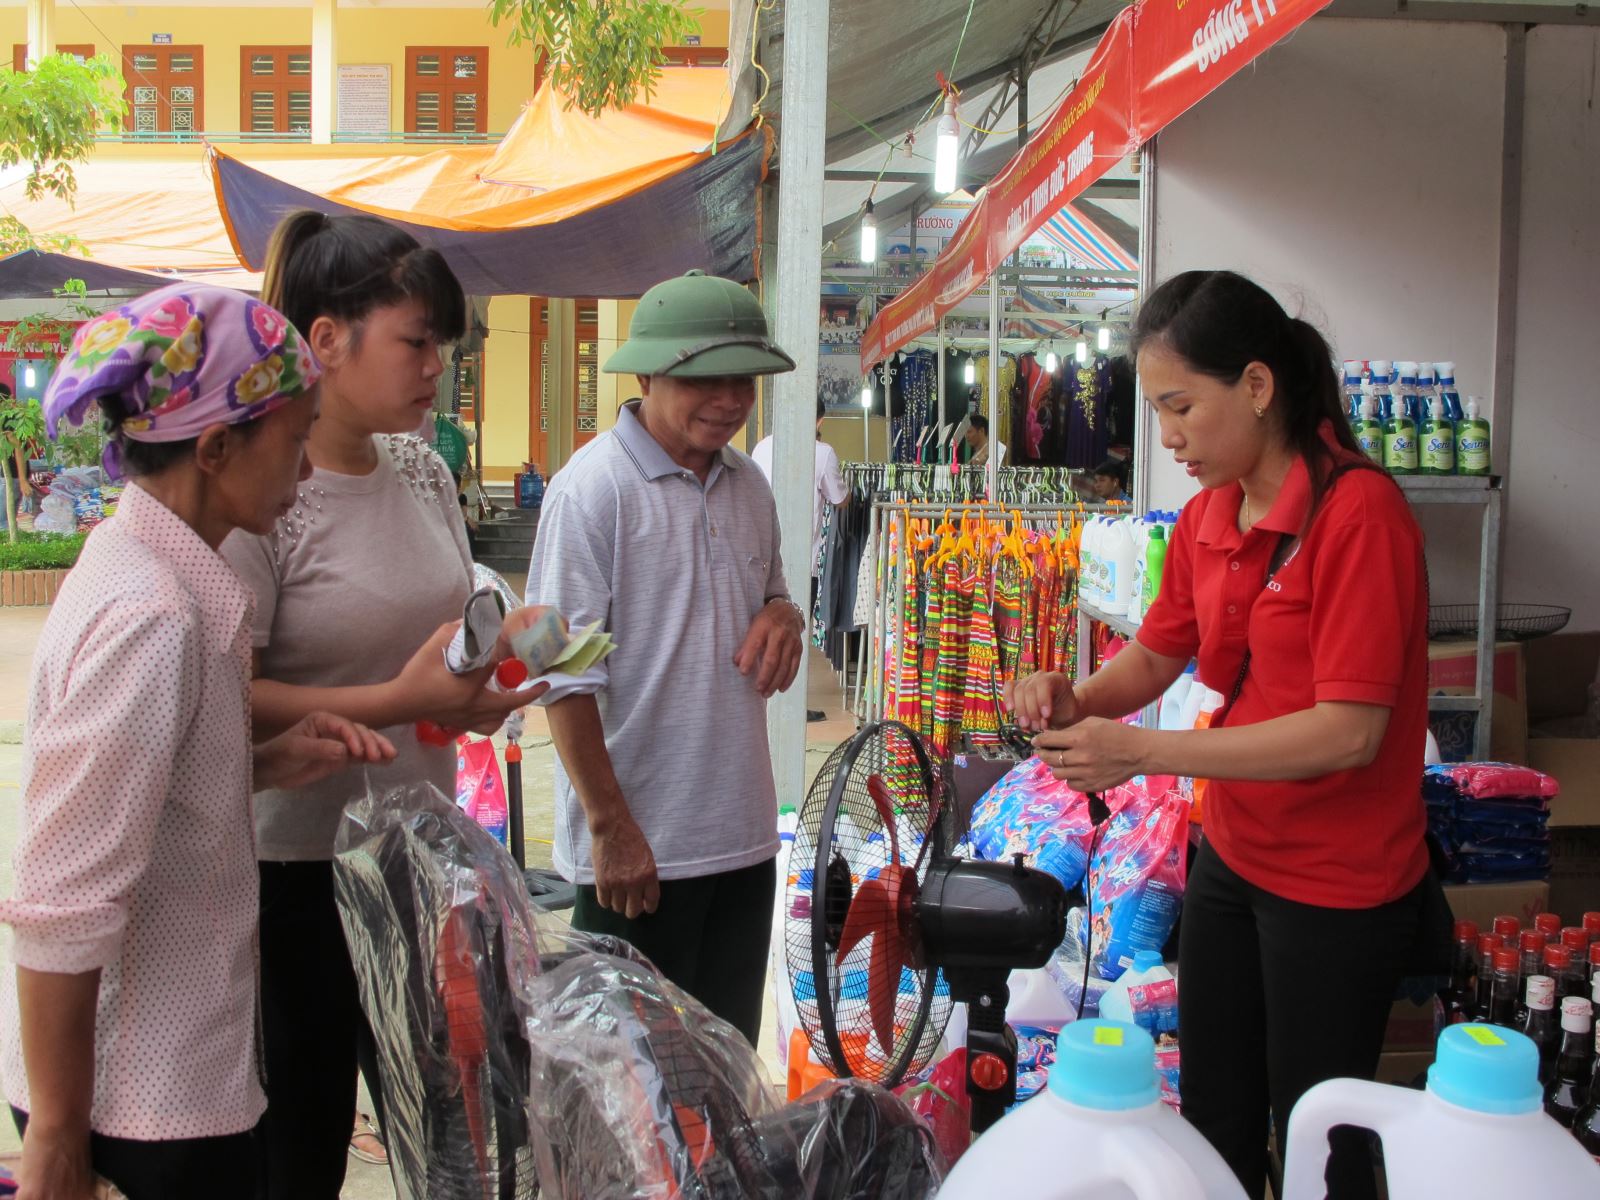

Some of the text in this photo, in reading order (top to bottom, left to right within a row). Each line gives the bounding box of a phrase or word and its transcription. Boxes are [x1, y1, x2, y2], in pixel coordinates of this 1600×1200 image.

[1031, 176, 1048, 218] TNHH
[1049, 157, 1065, 201] ĐỨC
[1067, 130, 1094, 185] TRUNG
